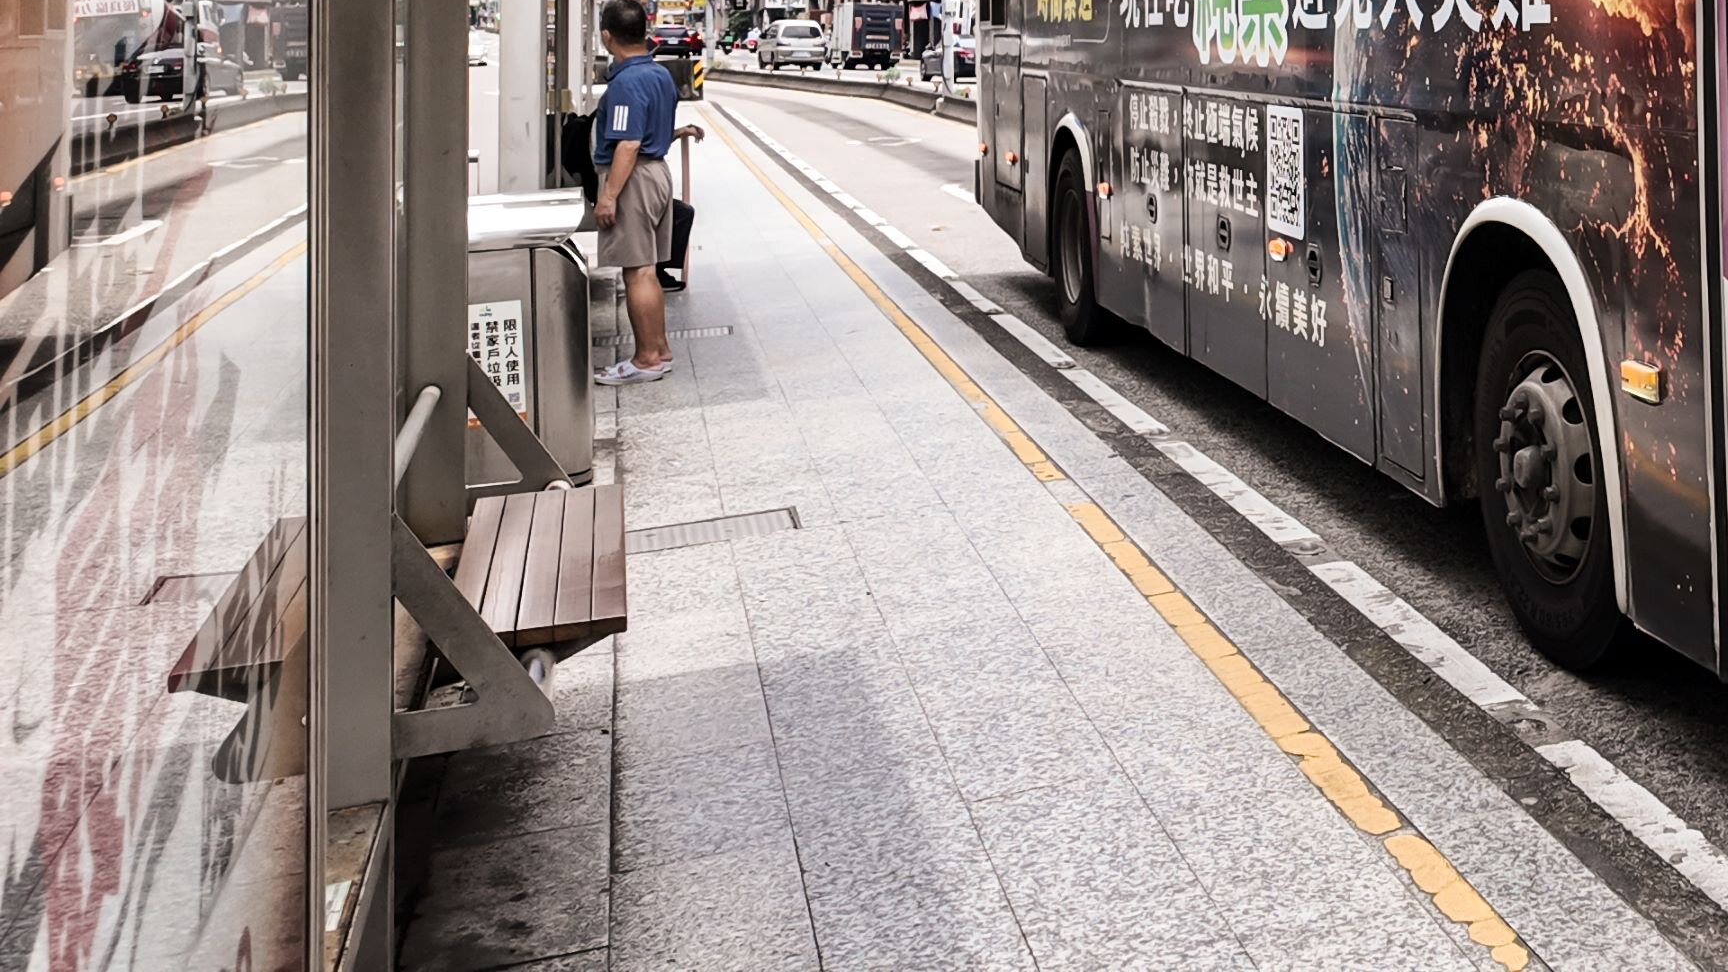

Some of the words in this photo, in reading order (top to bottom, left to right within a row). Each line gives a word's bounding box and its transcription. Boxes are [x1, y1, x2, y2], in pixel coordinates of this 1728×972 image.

[504, 319, 520, 386] 限行人使用
